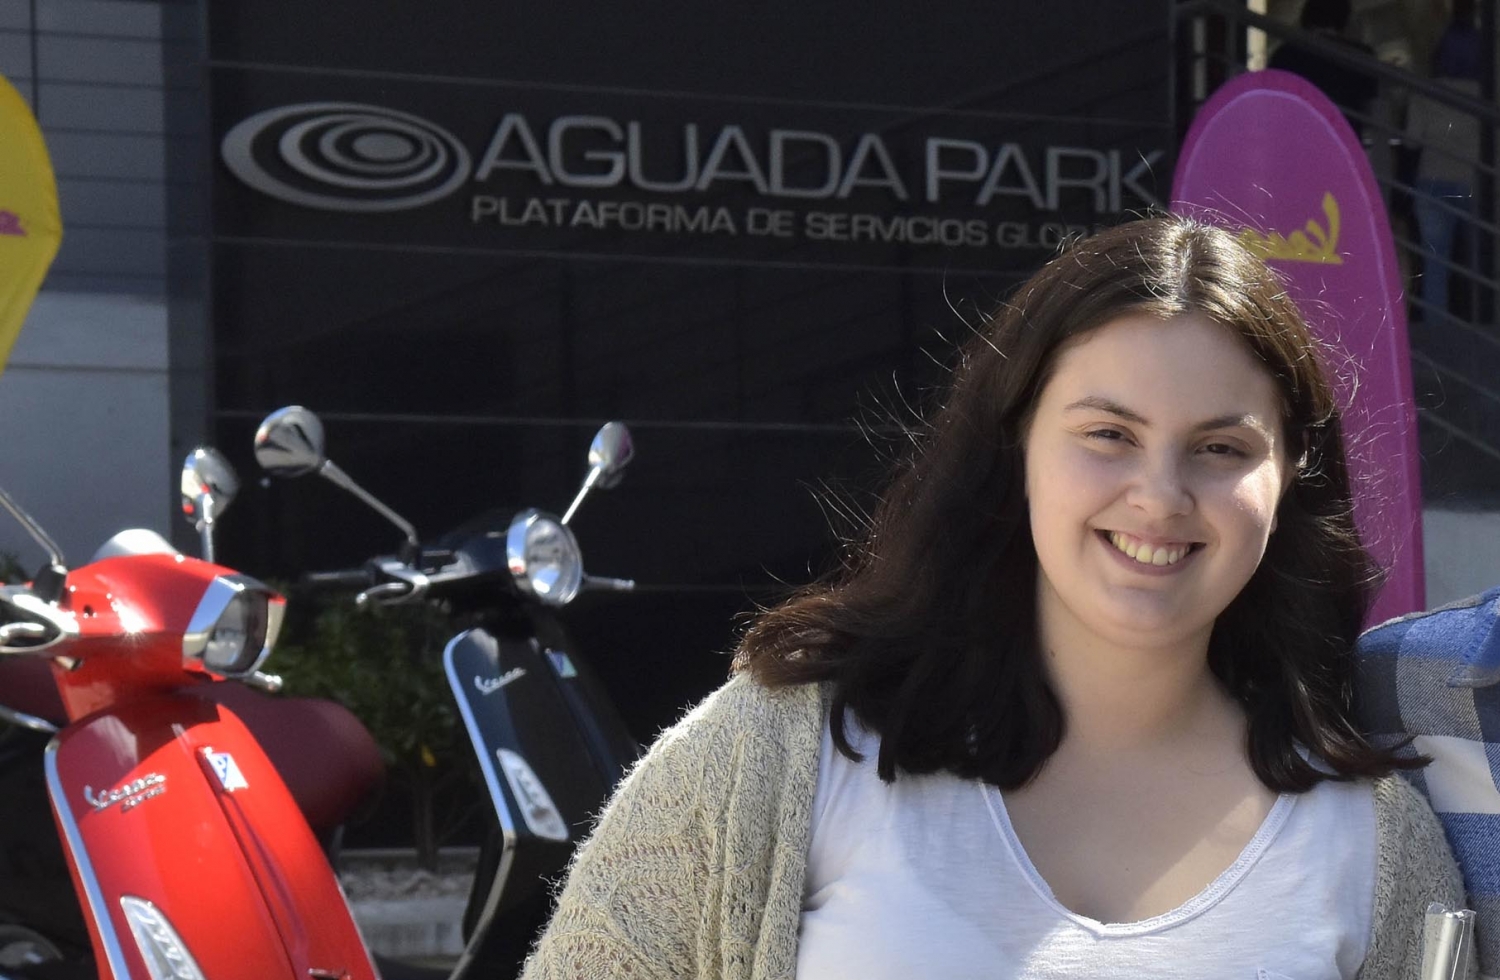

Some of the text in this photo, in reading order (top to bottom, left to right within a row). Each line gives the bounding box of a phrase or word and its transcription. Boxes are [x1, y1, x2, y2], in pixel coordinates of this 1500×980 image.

[474, 112, 1166, 213] AGUADA PARK
[472, 195, 736, 235] PLATAFORMA
[746, 208, 795, 238] DE
[805, 211, 988, 247] SERVICIOS
